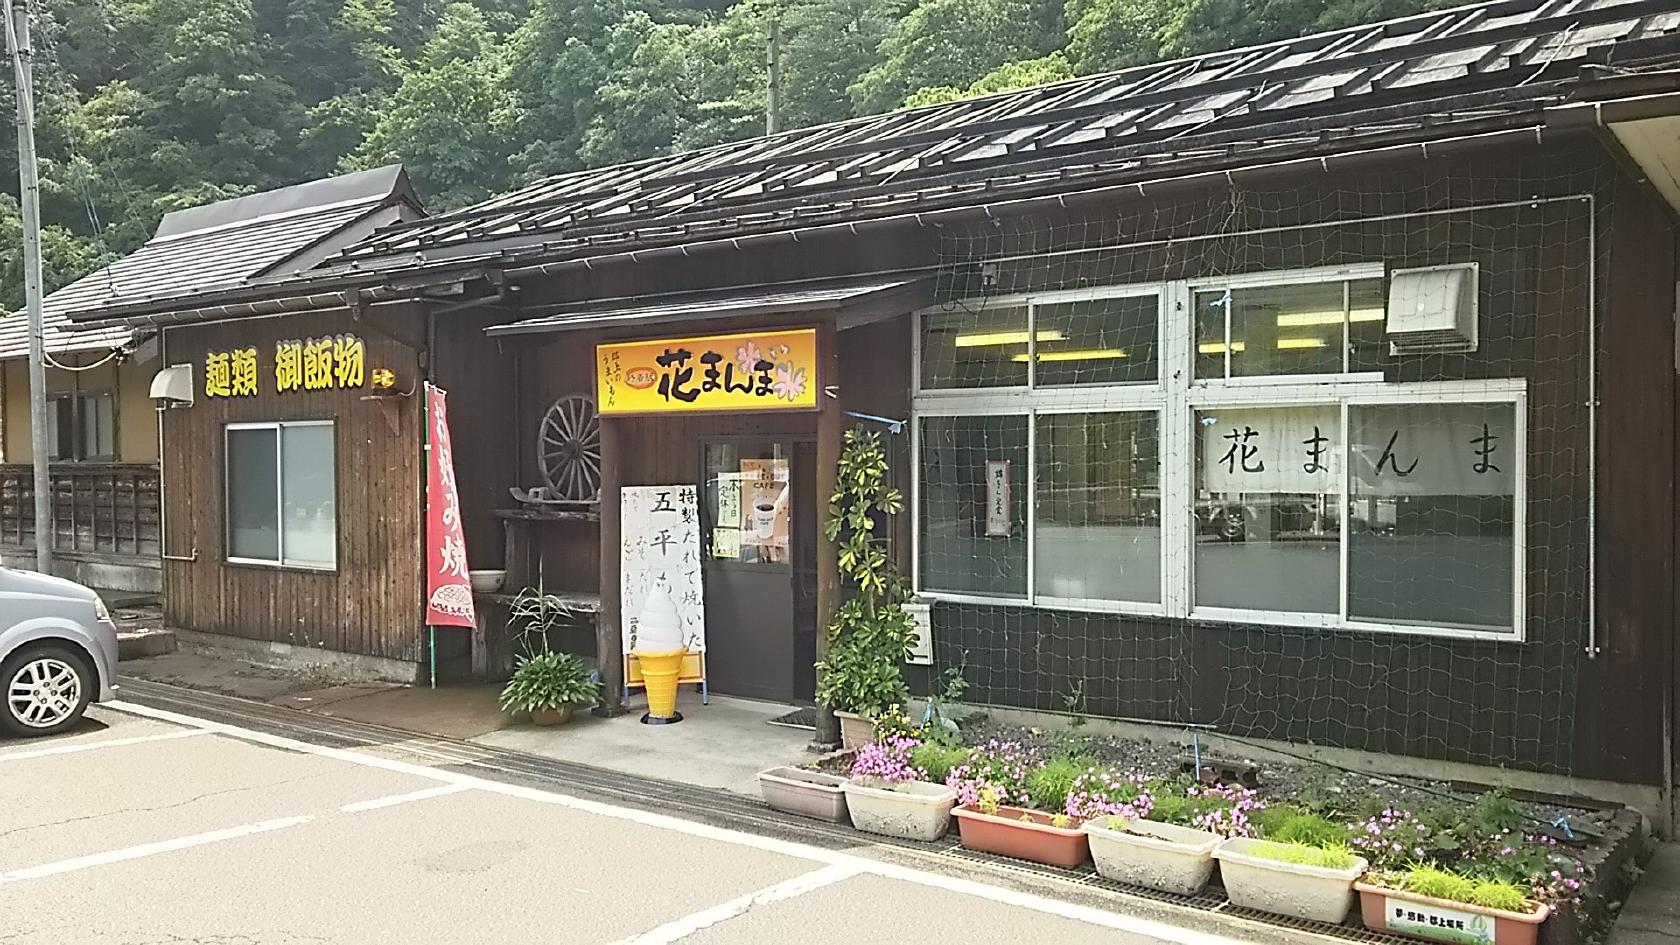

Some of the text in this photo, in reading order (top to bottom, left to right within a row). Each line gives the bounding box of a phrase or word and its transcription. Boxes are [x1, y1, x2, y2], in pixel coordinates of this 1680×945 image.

[204, 336, 366, 398] 麺類 御飯物
[656, 348, 775, 403] 花まんま
[1218, 423, 1501, 478] 花まんま
[434, 401, 469, 580] お好み焼
